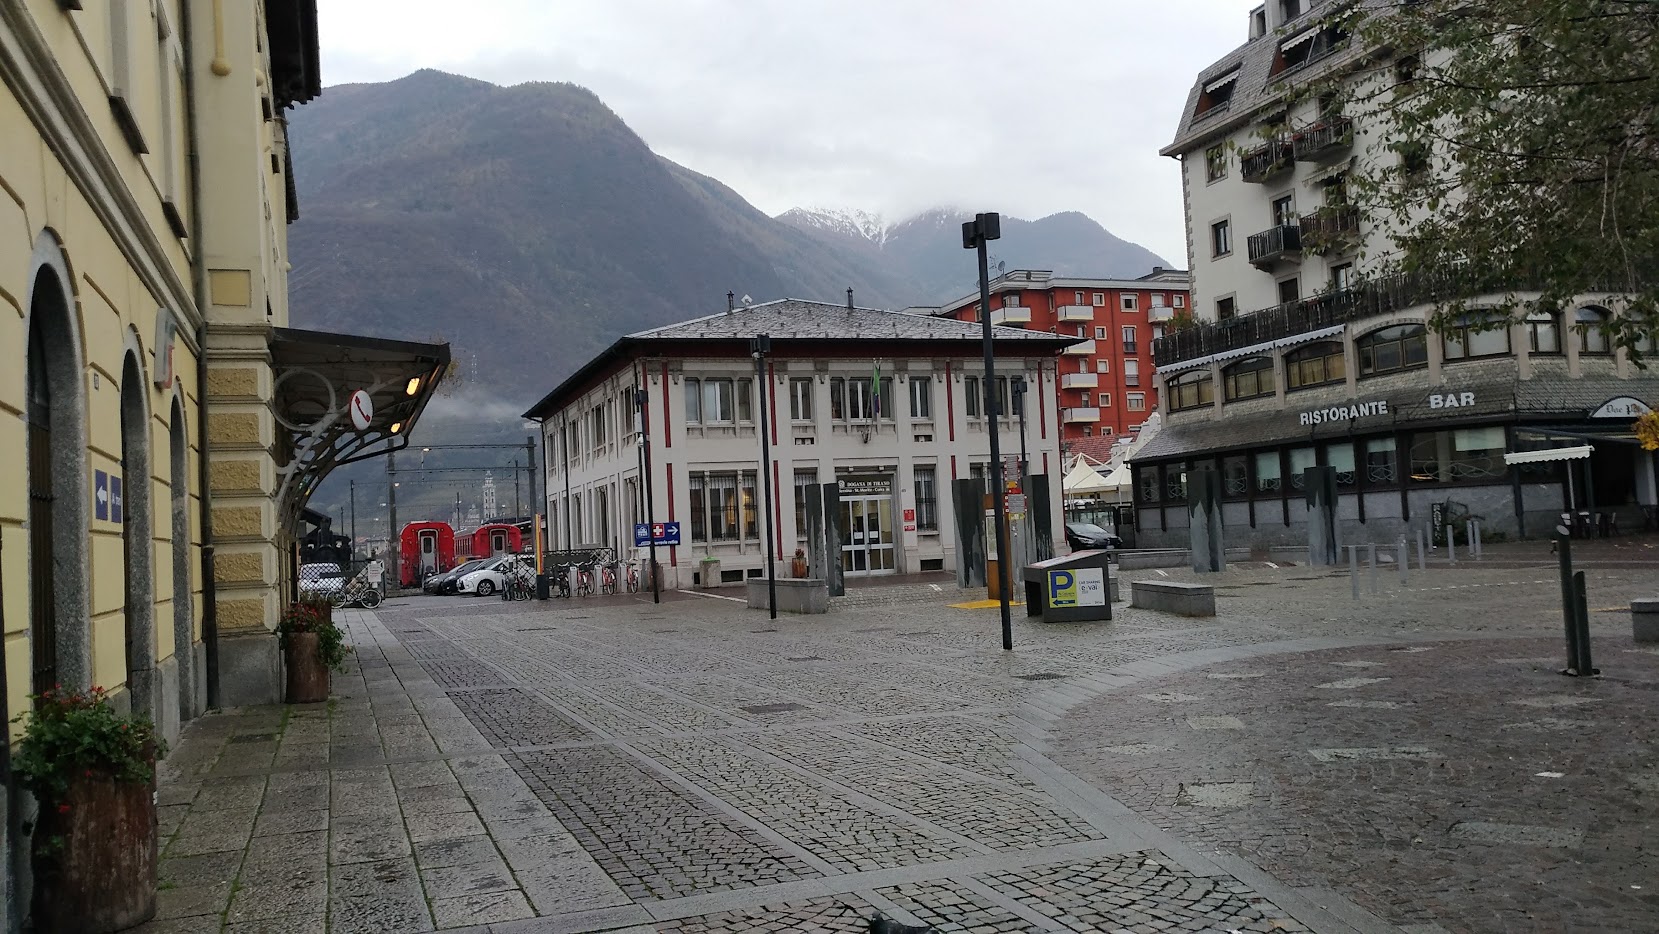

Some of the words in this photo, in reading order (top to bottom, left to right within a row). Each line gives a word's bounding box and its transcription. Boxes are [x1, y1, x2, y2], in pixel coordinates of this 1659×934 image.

[1299, 400, 1389, 426] RISTORANTE
[1429, 392, 1476, 409] BAR
[1050, 571, 1074, 598] P
